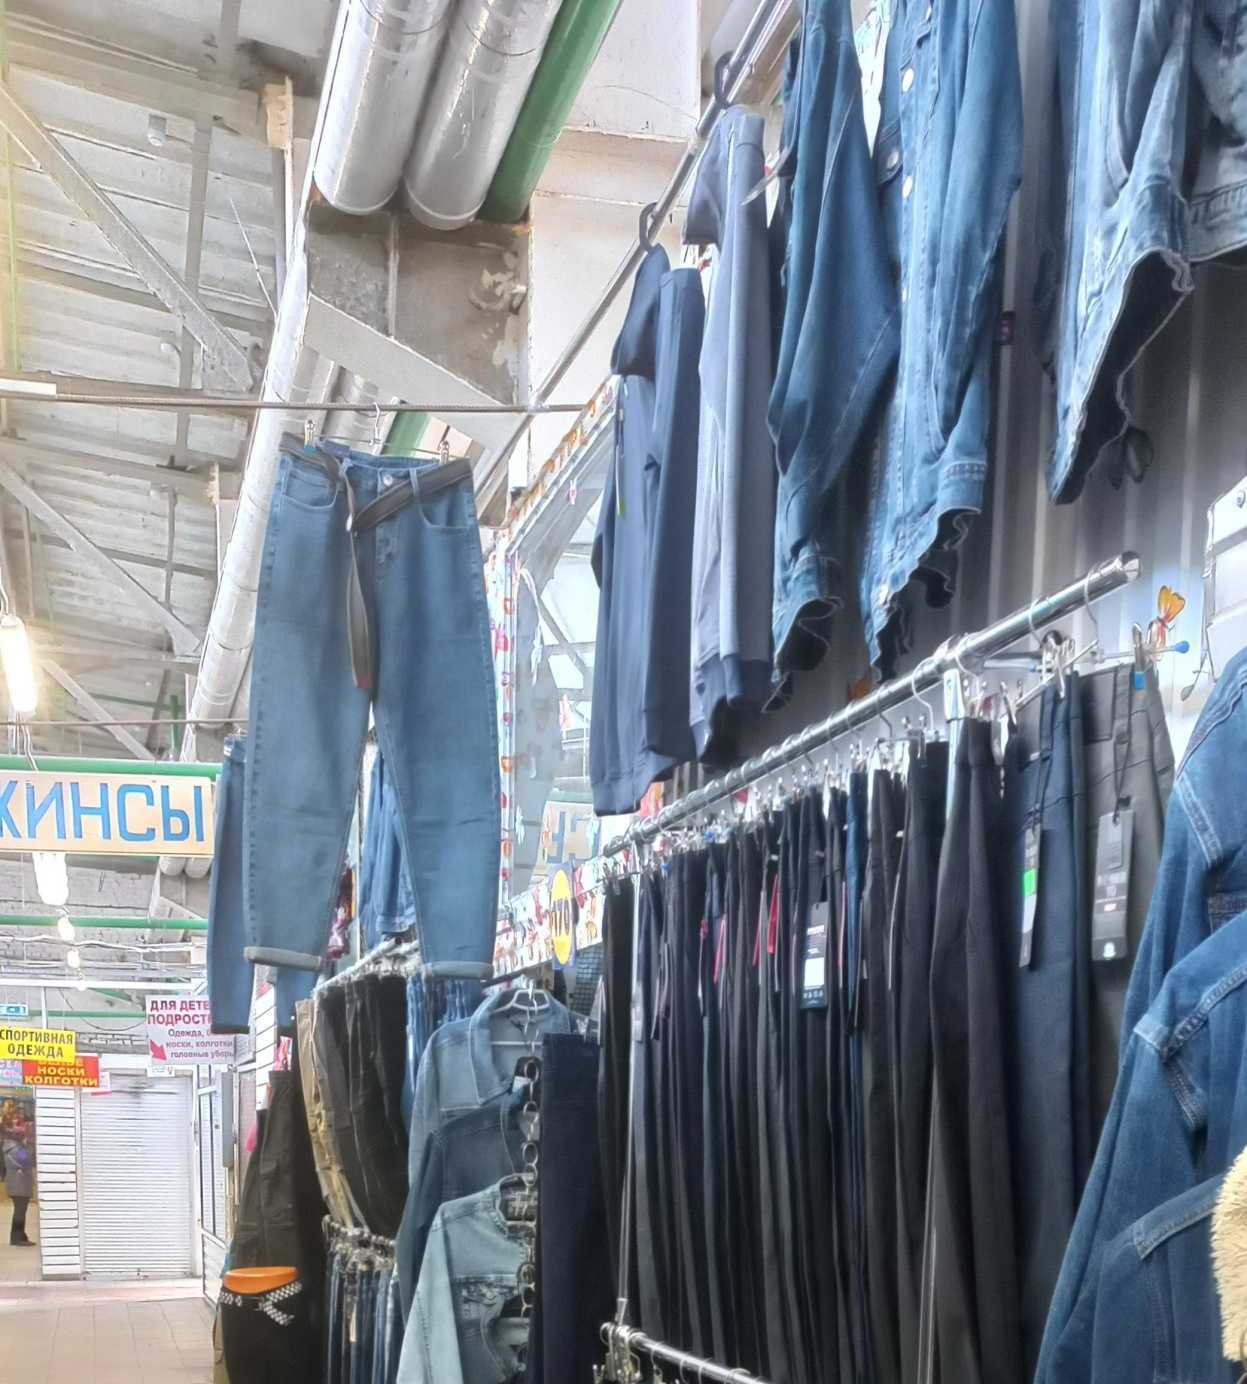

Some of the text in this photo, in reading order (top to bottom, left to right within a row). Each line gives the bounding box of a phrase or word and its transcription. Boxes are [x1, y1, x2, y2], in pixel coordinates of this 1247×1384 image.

[150, 1000, 210, 1012] ДЛЯ ДЕТЕ
[0, 1029, 73, 1045] СПОРТИВНАЯ
[168, 1029, 205, 1037] Одежда,
[8, 1043, 64, 1058] ОДЕЖДА
[166, 1041, 194, 1049] носки,
[37, 1066, 85, 1076] НОСКИ
[24, 1075, 98, 1087] КОЛГОТКИ
